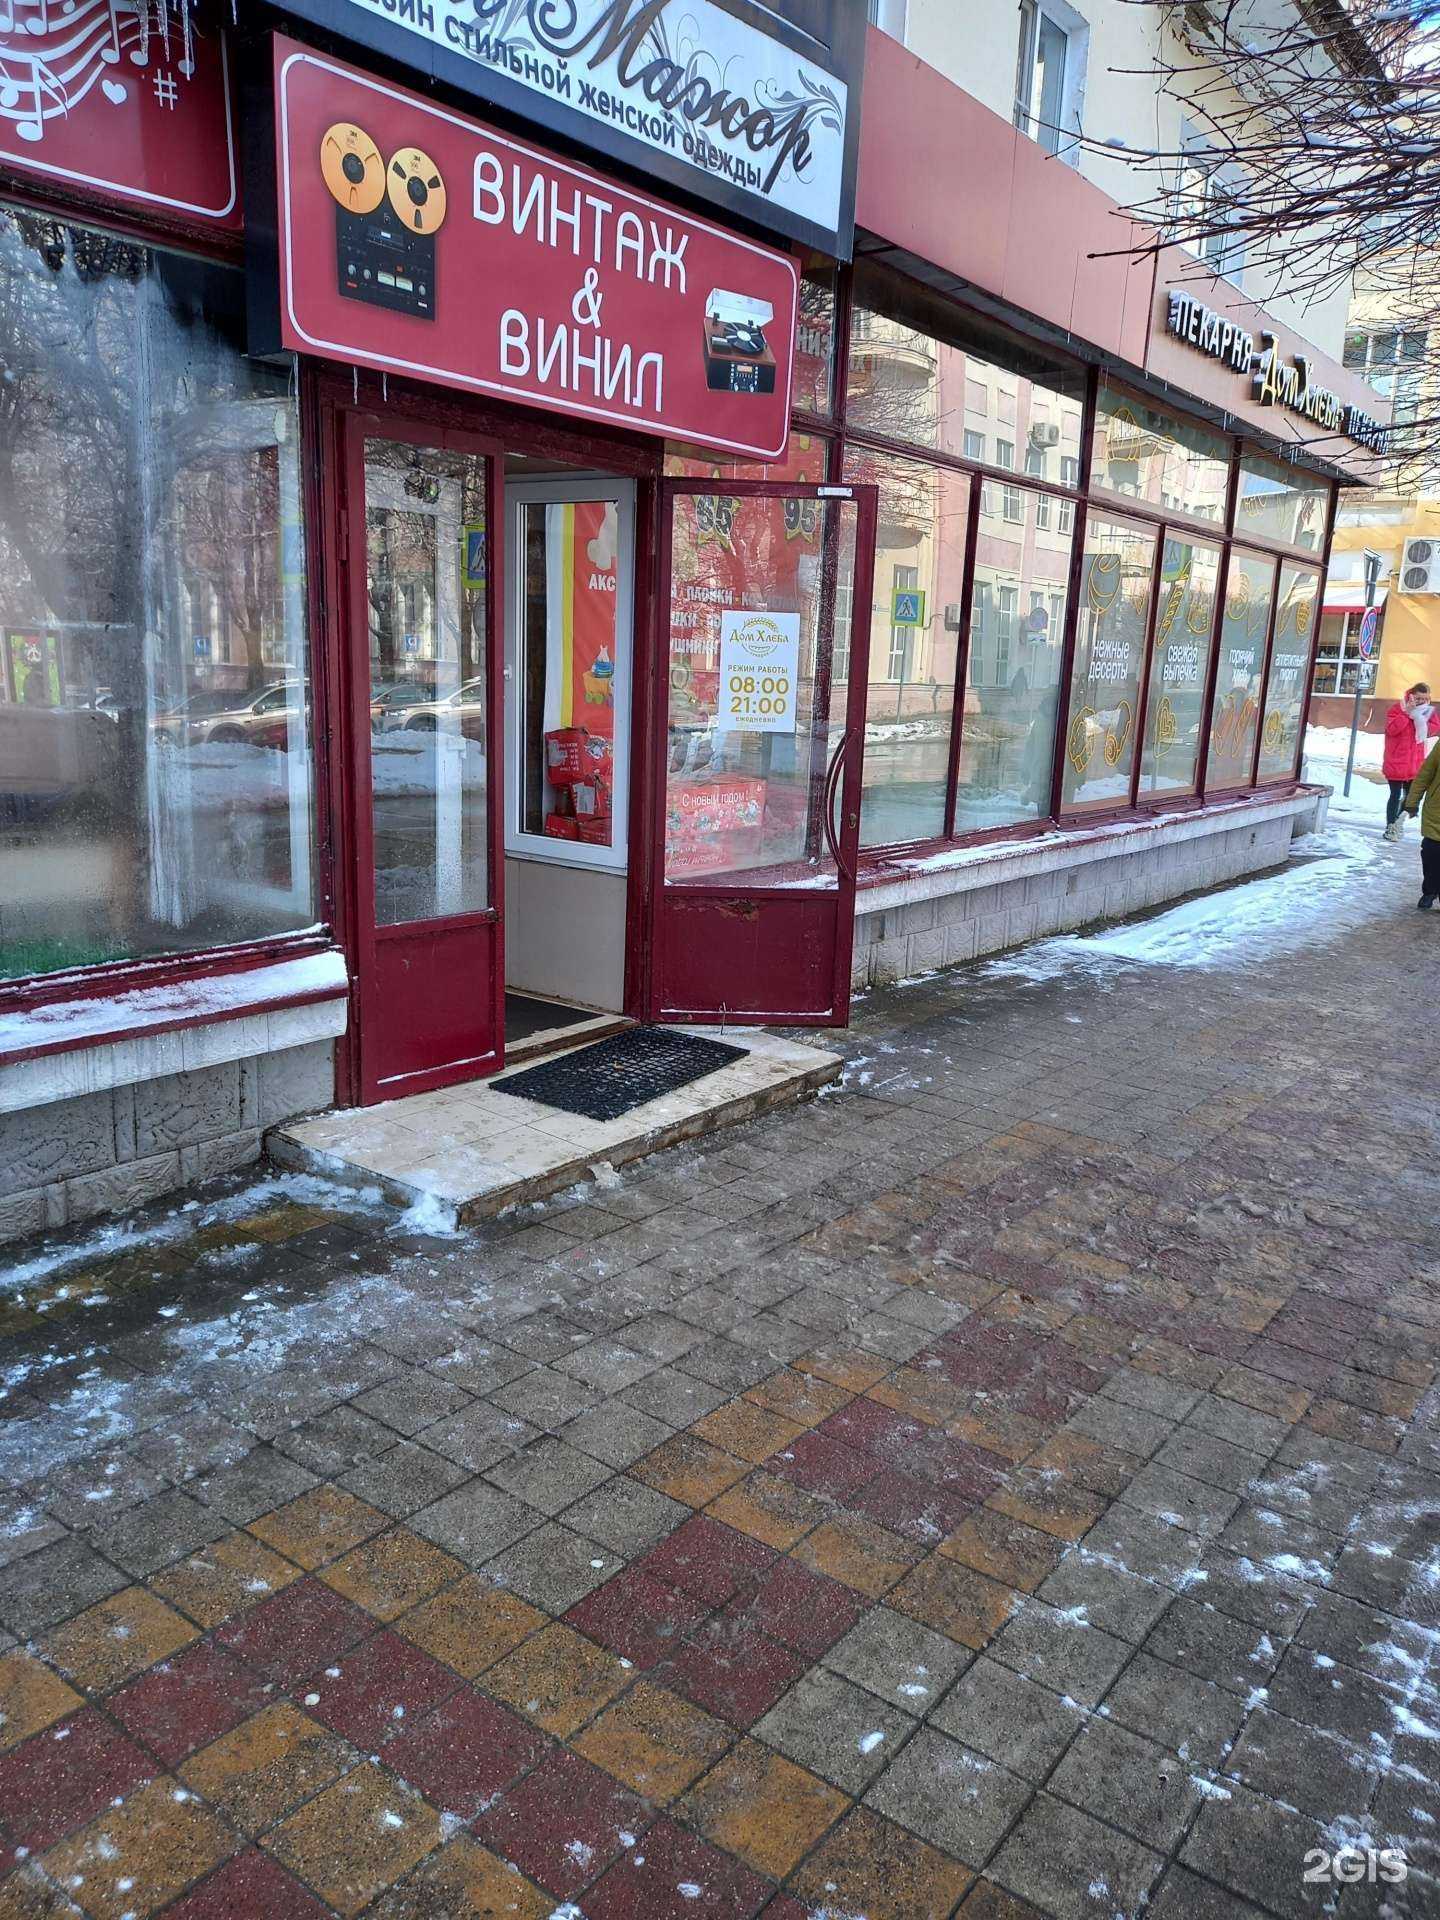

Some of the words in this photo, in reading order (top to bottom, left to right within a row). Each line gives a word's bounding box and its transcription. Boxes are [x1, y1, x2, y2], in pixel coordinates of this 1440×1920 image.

[444, 15, 571, 99] стильной
[577, 79, 676, 148] женской
[682, 131, 762, 190] одежды
[473, 151, 689, 294] ВИНТАЖ
[572, 267, 603, 329] &
[1172, 294, 1254, 374] ПЕКАРНЯ
[500, 309, 663, 413] ВИНИЛ
[1092, 639, 1130, 660] нежные
[1167, 643, 1198, 663] свежая
[727, 664, 755, 673] РЕЖИМ
[757, 665, 788, 674] РАБОТЫ
[1087, 660, 1129, 684] десерты
[1162, 663, 1198, 681] выпечка
[729, 676, 789, 695] 08:00
[730, 696, 786, 715] 21:00
